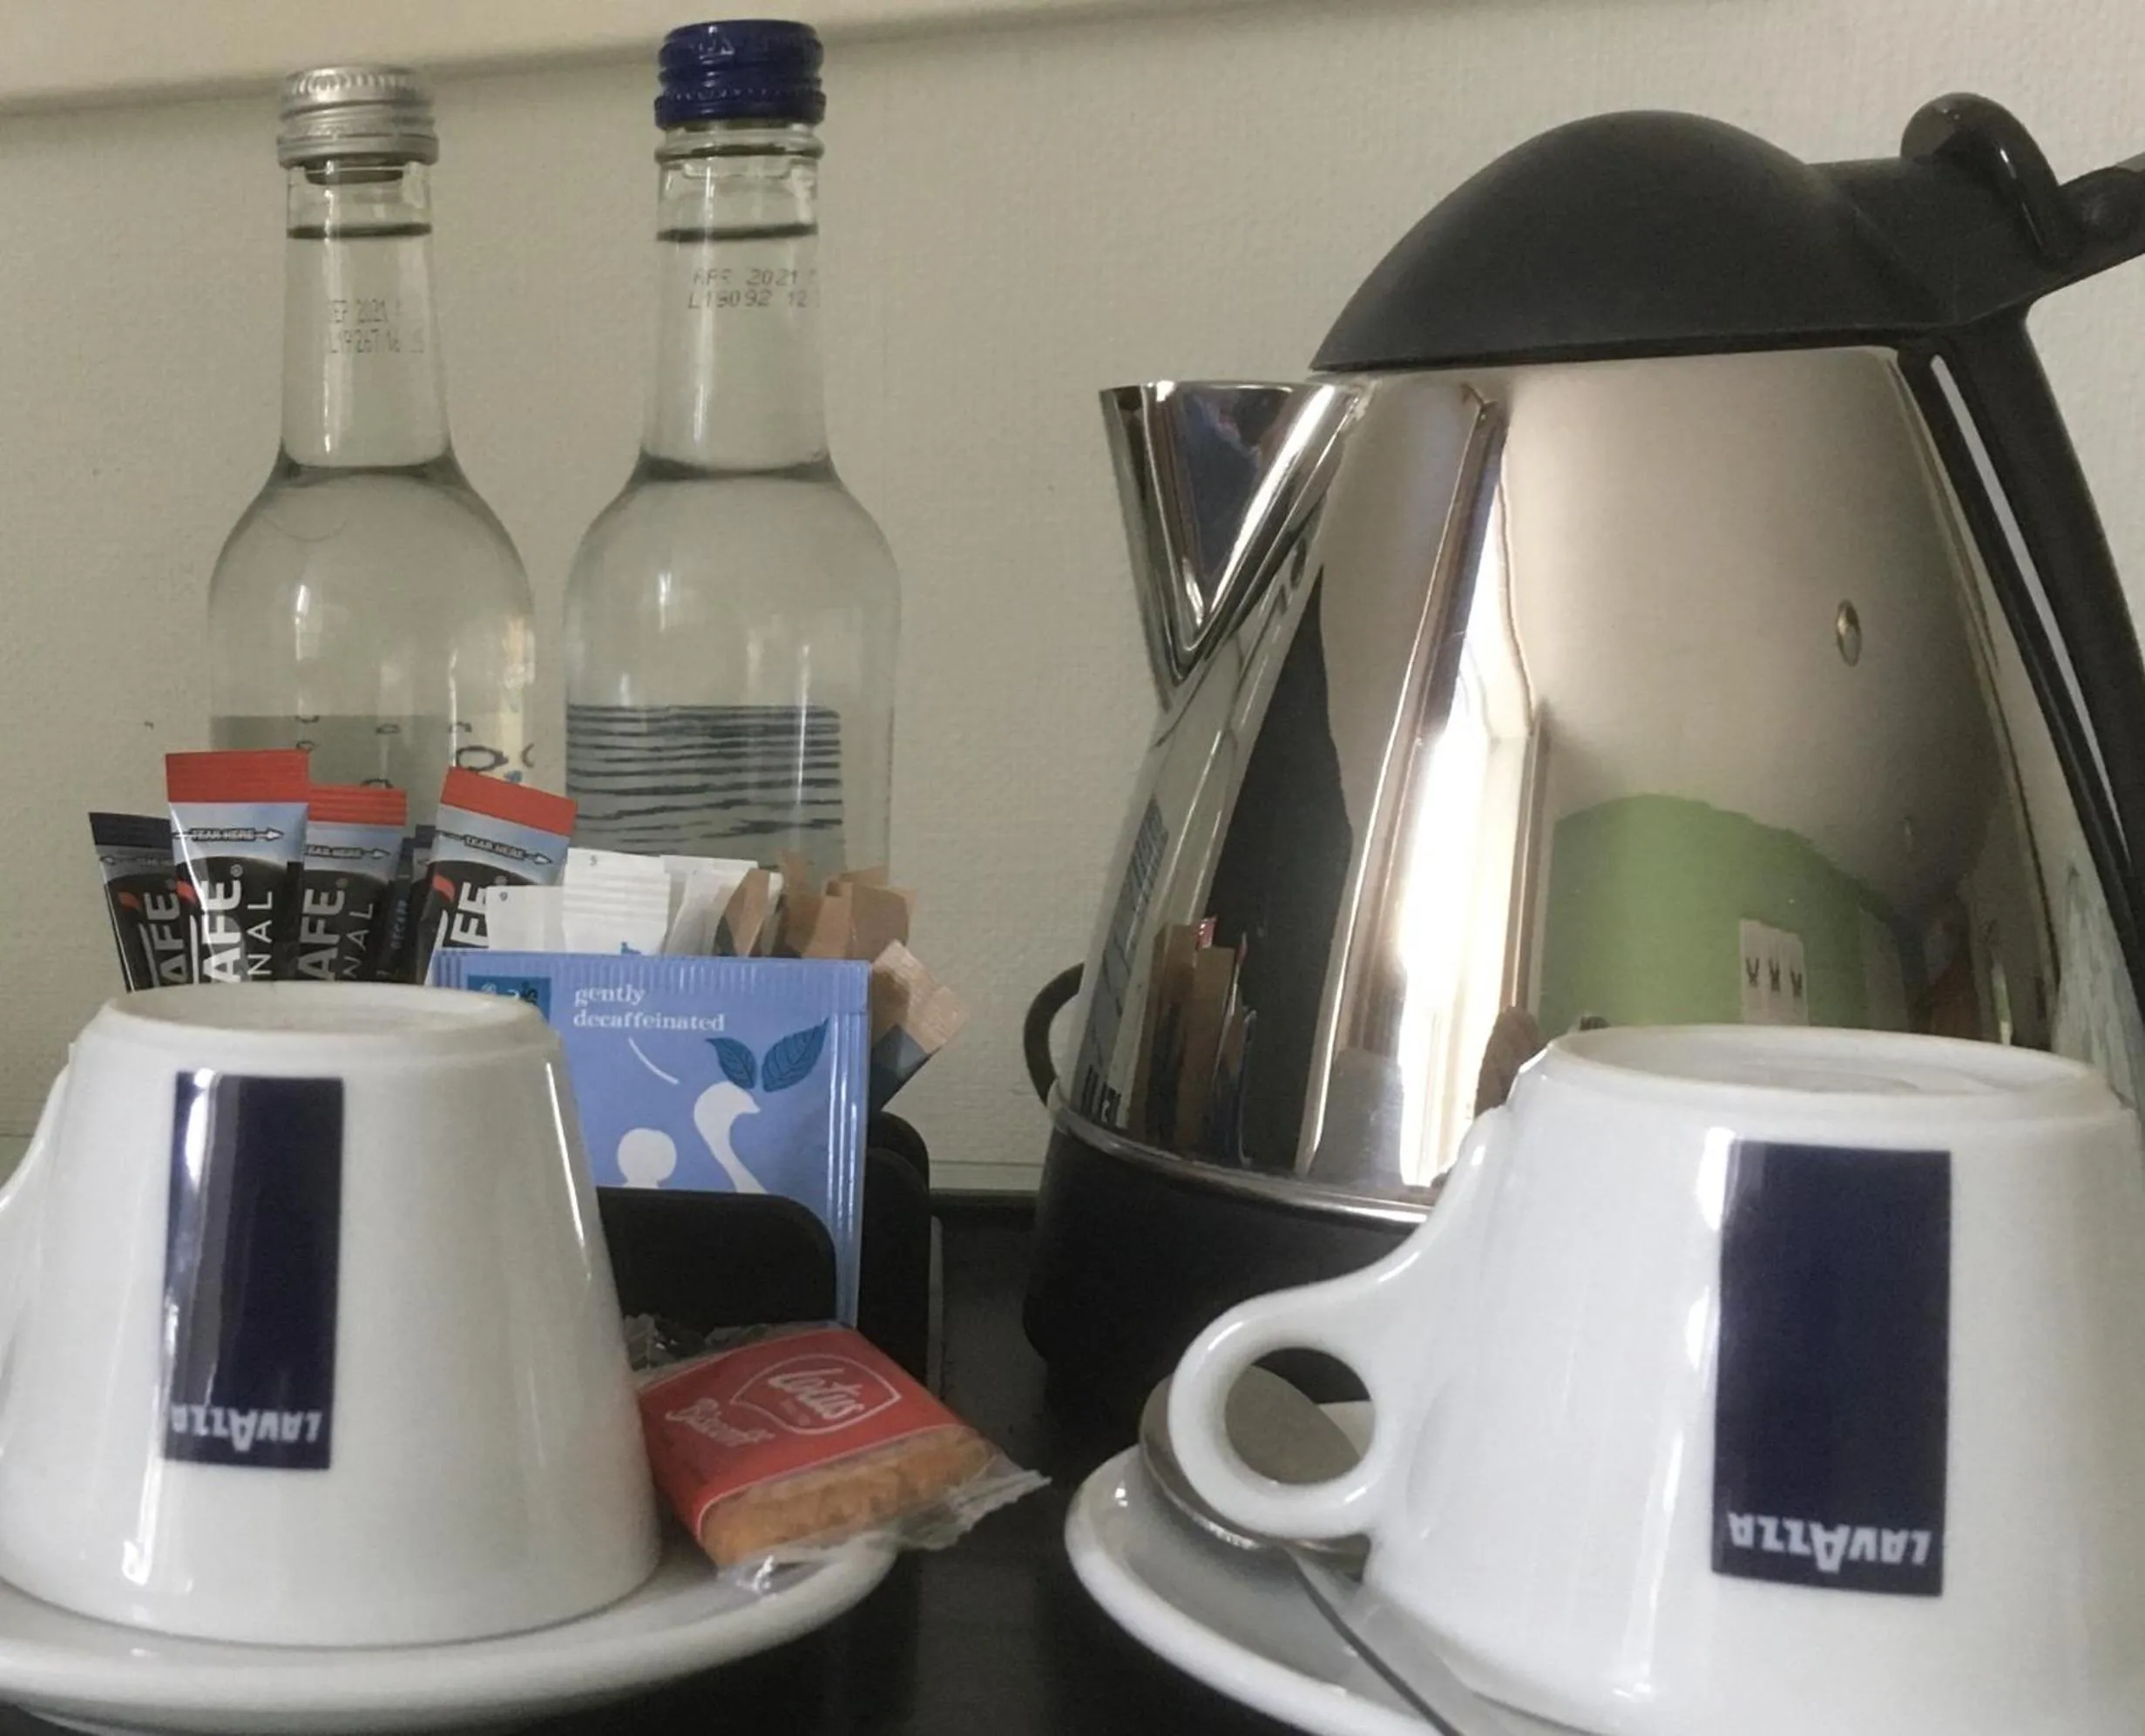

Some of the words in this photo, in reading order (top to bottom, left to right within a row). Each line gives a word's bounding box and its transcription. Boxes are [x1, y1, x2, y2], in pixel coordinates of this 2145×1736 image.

[746, 267, 798, 287] 2021
[573, 983, 646, 1007] gently
[572, 1009, 725, 1032] decaffeinated
[171, 1403, 322, 1453] LAVAZZA
[1726, 1510, 1932, 1574] LAVAZZA
